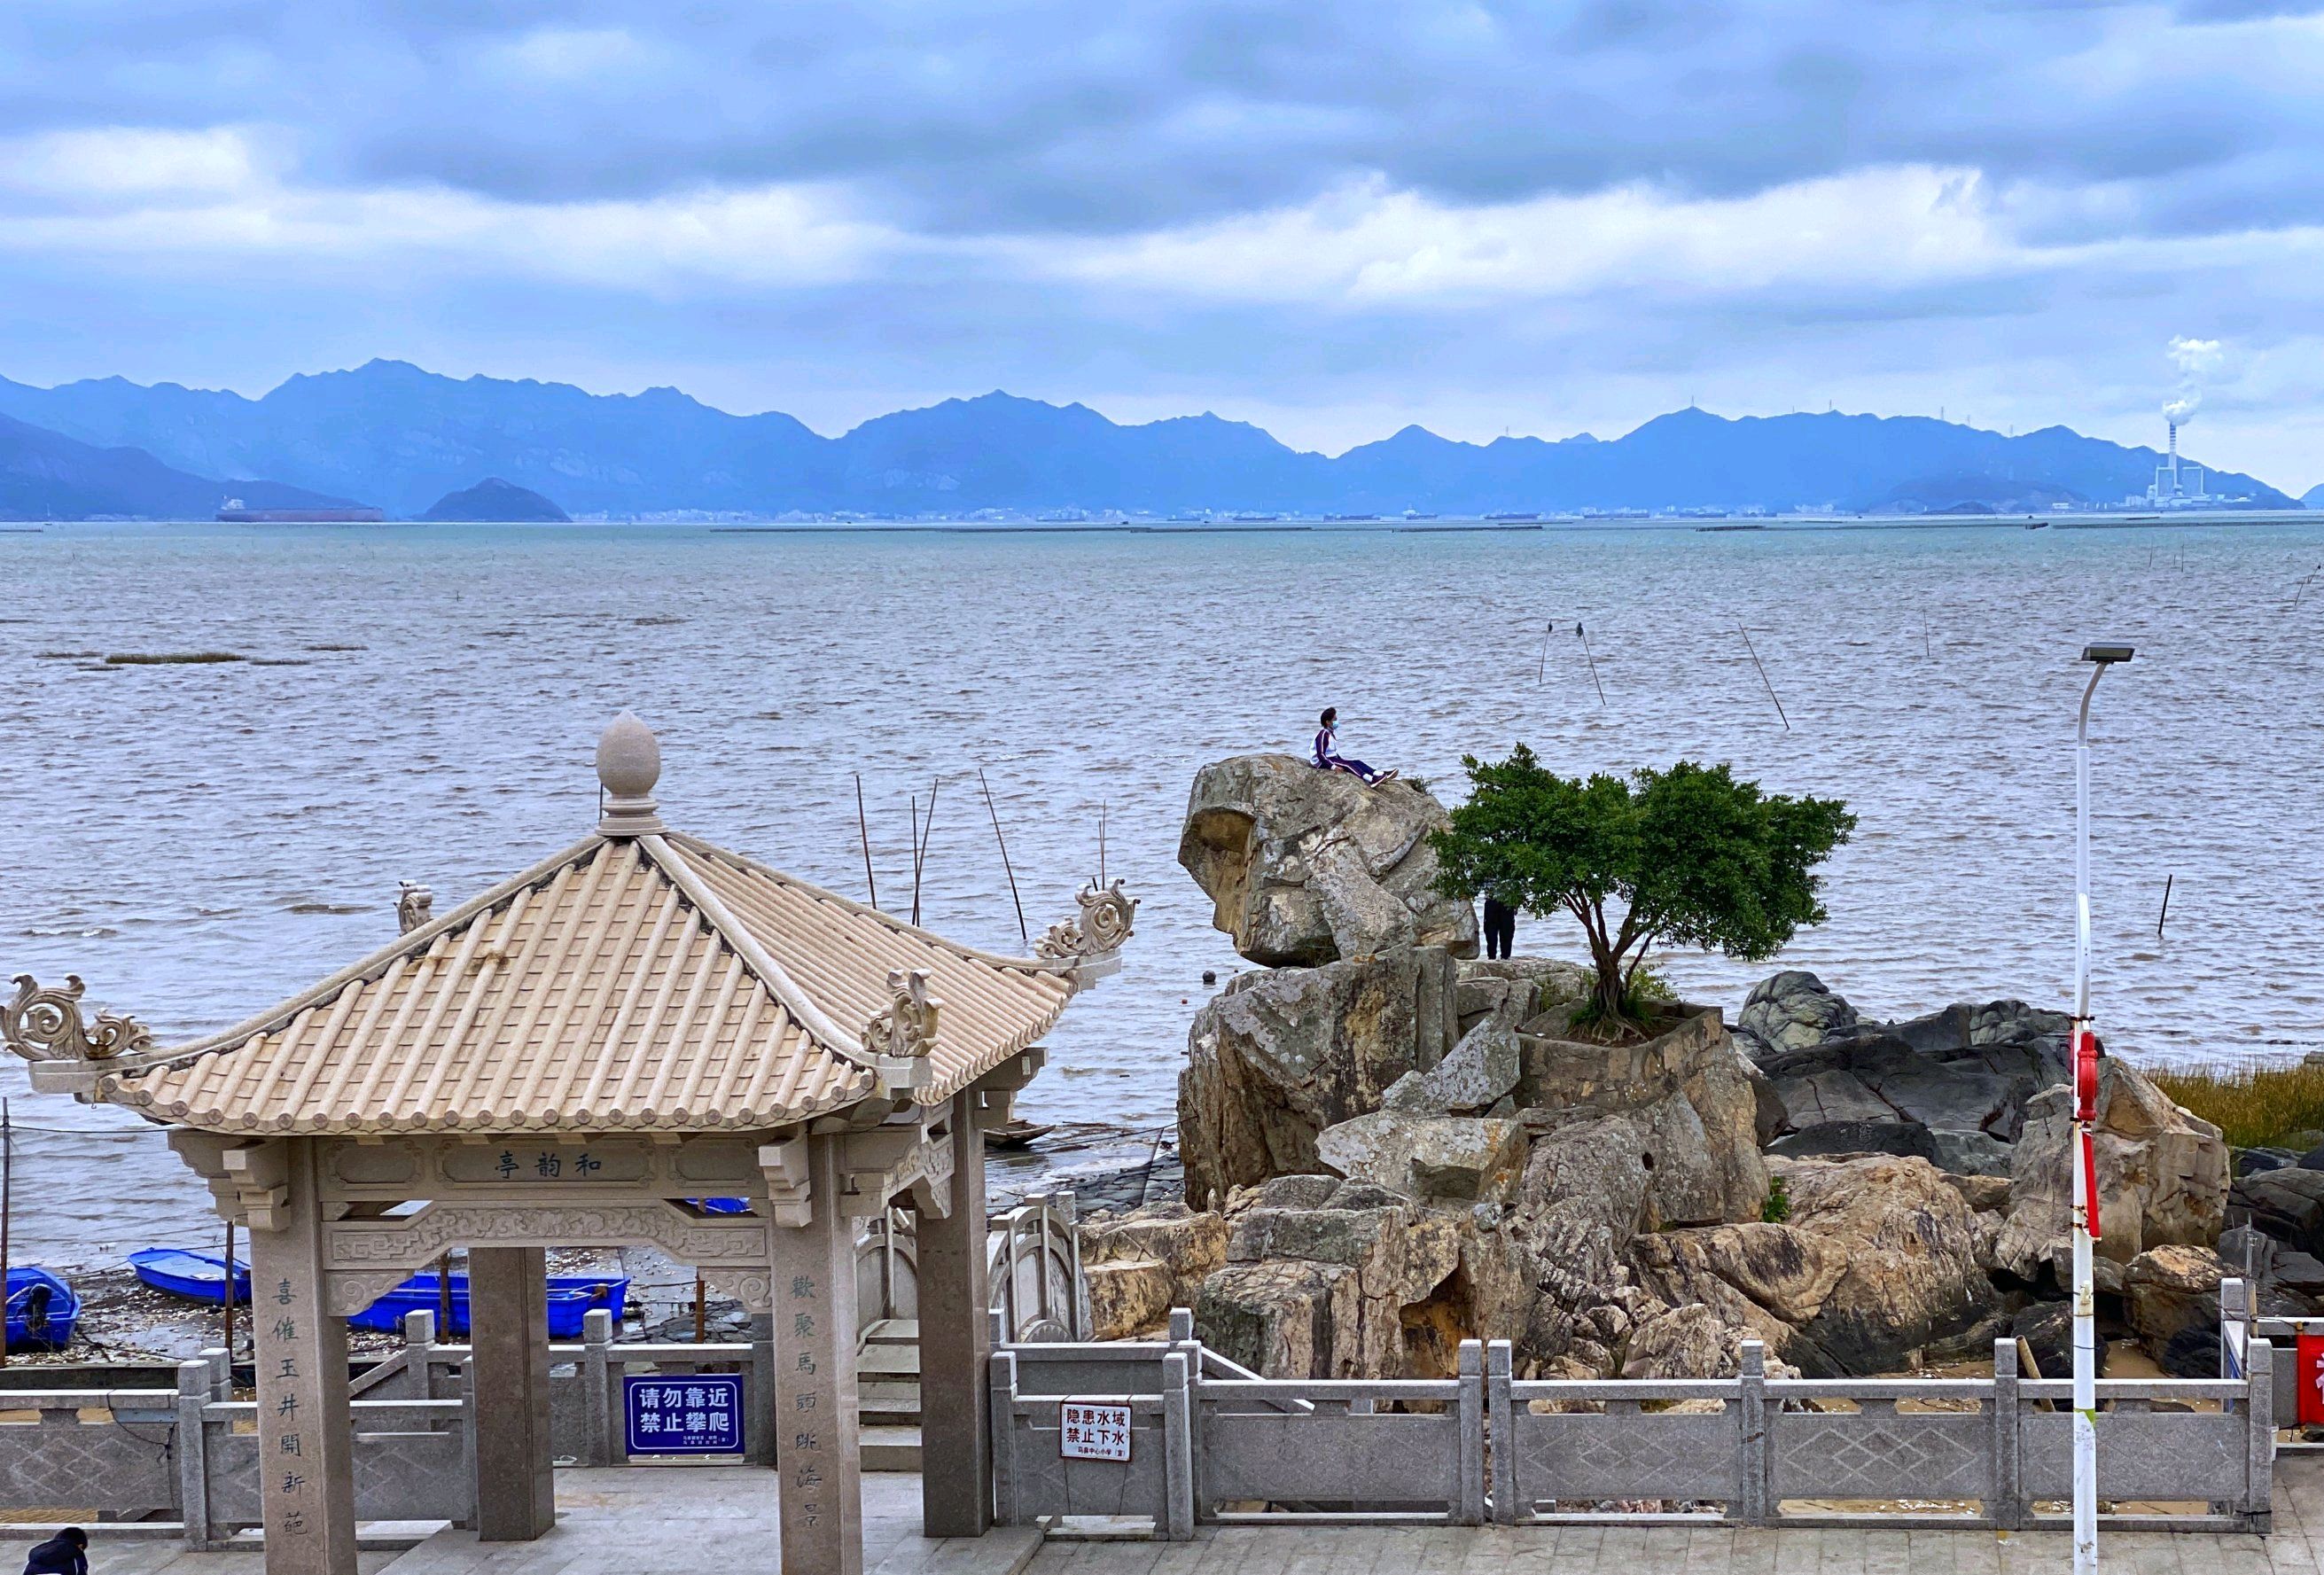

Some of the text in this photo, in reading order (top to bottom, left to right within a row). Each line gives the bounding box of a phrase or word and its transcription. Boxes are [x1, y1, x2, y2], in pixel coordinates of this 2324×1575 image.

[639, 1387, 729, 1408] 请勿靠近
[640, 1412, 730, 1433] 禁止攀爬
[1066, 1408, 1126, 1427] 隐患水域
[1066, 1427, 1125, 1446] 禁止下水
